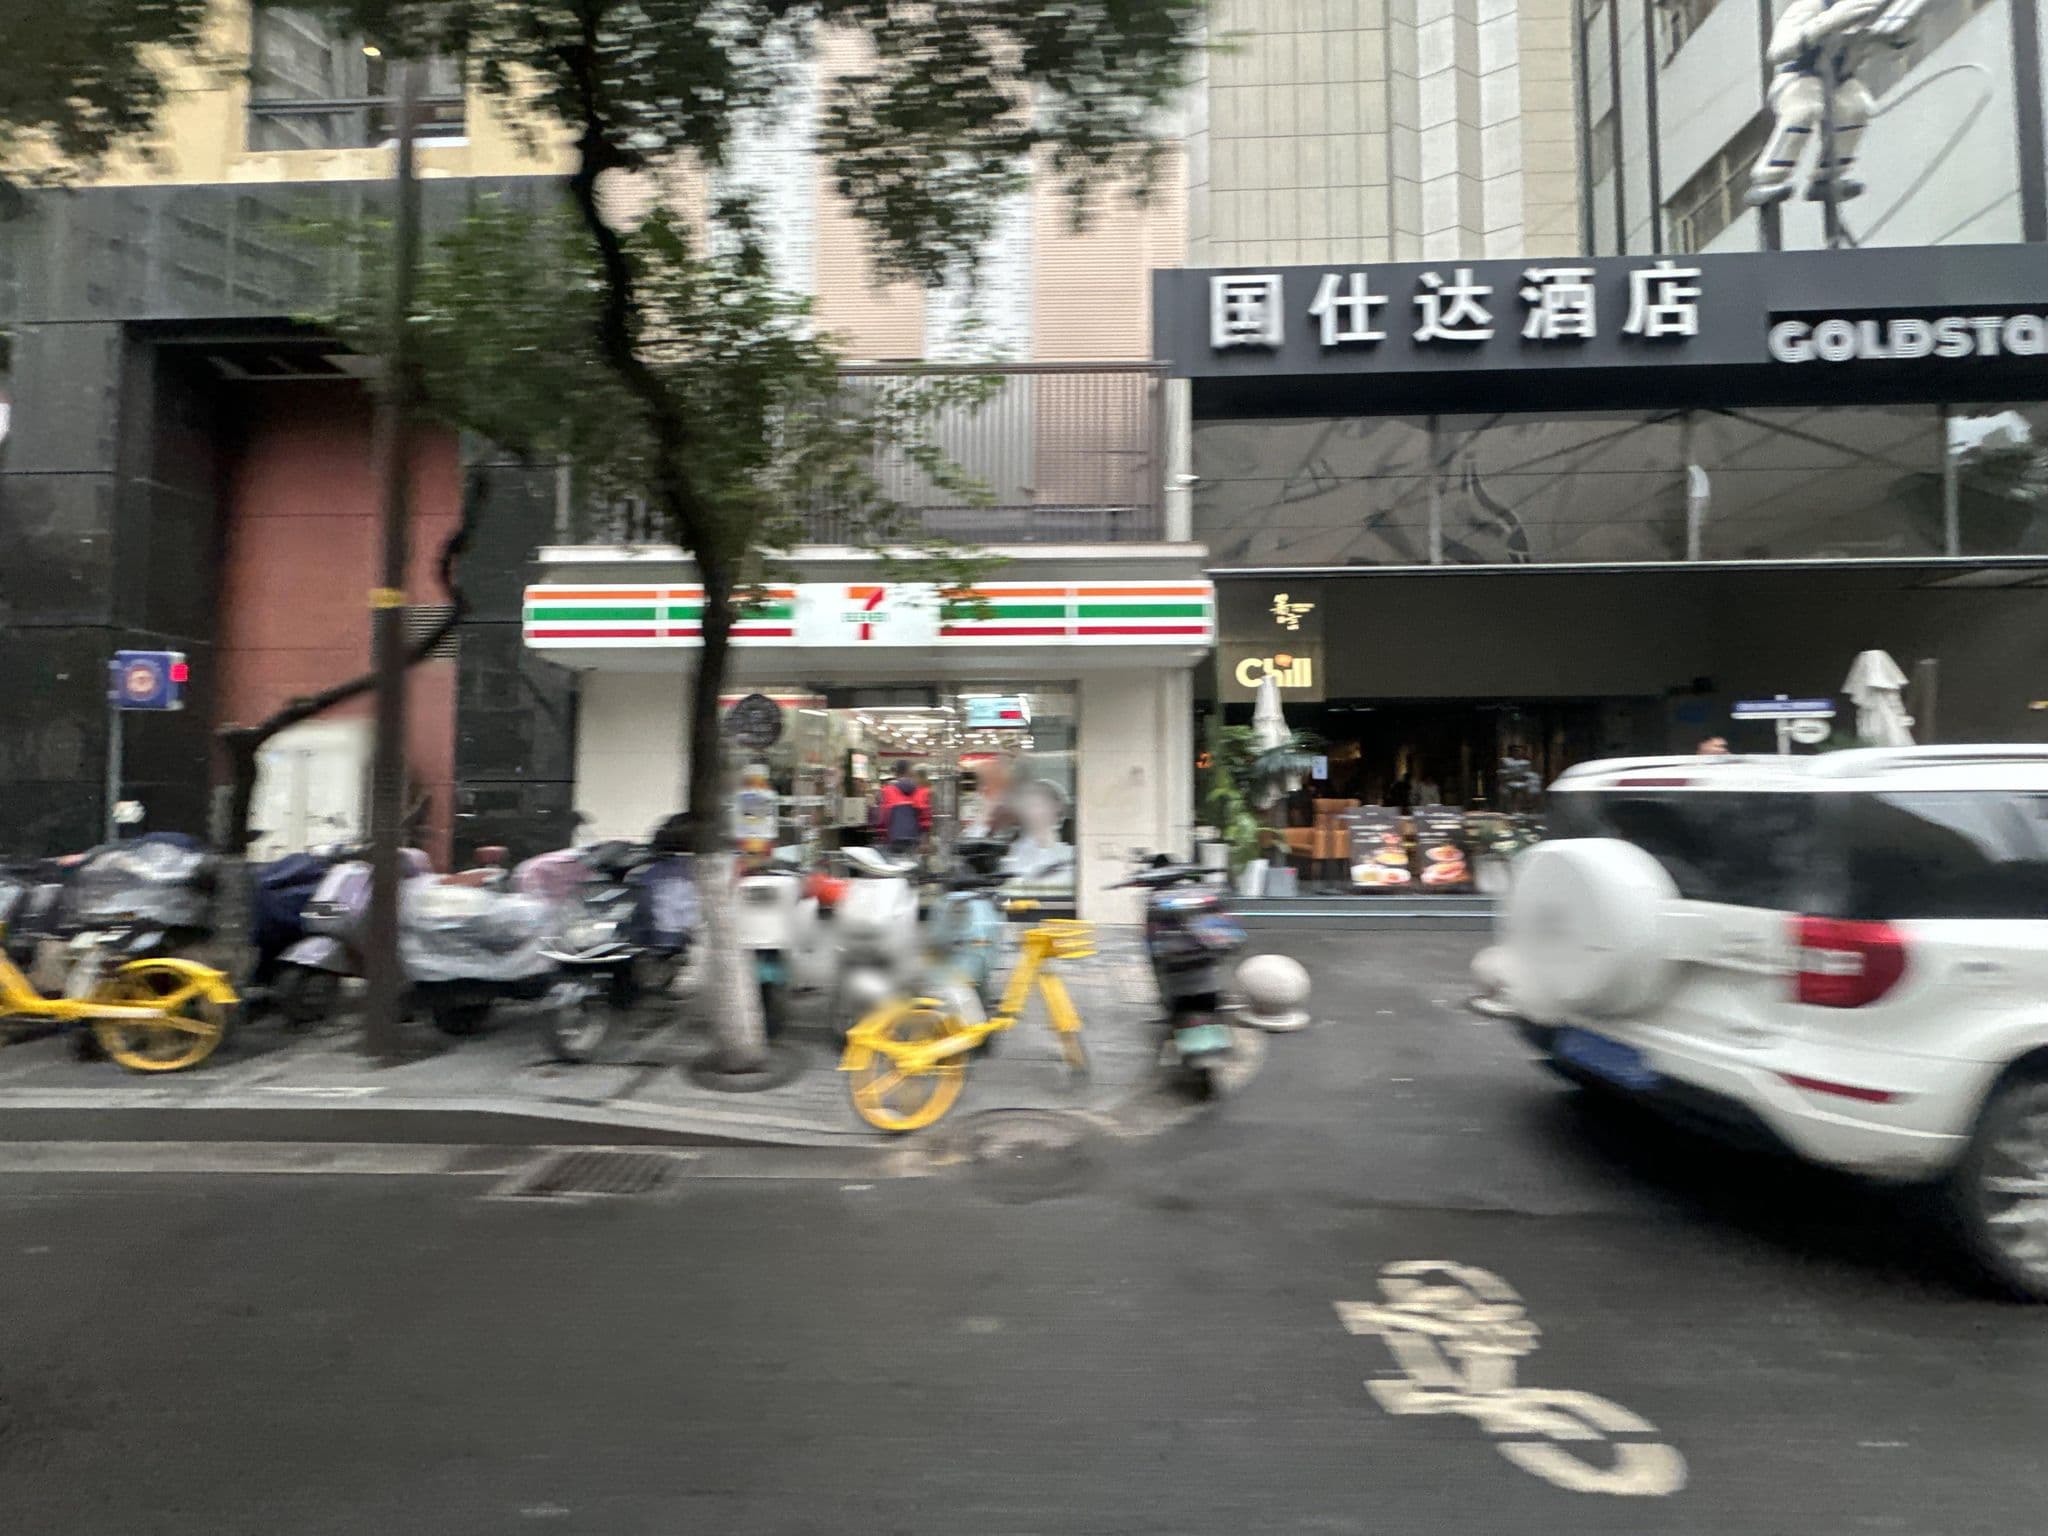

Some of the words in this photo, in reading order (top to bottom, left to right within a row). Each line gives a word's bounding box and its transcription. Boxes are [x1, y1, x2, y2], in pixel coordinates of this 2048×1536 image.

[1209, 260, 1702, 348] 国仕达酒店
[1768, 314, 2048, 363] GOLDSTO
[1235, 656, 1312, 688] Chill
